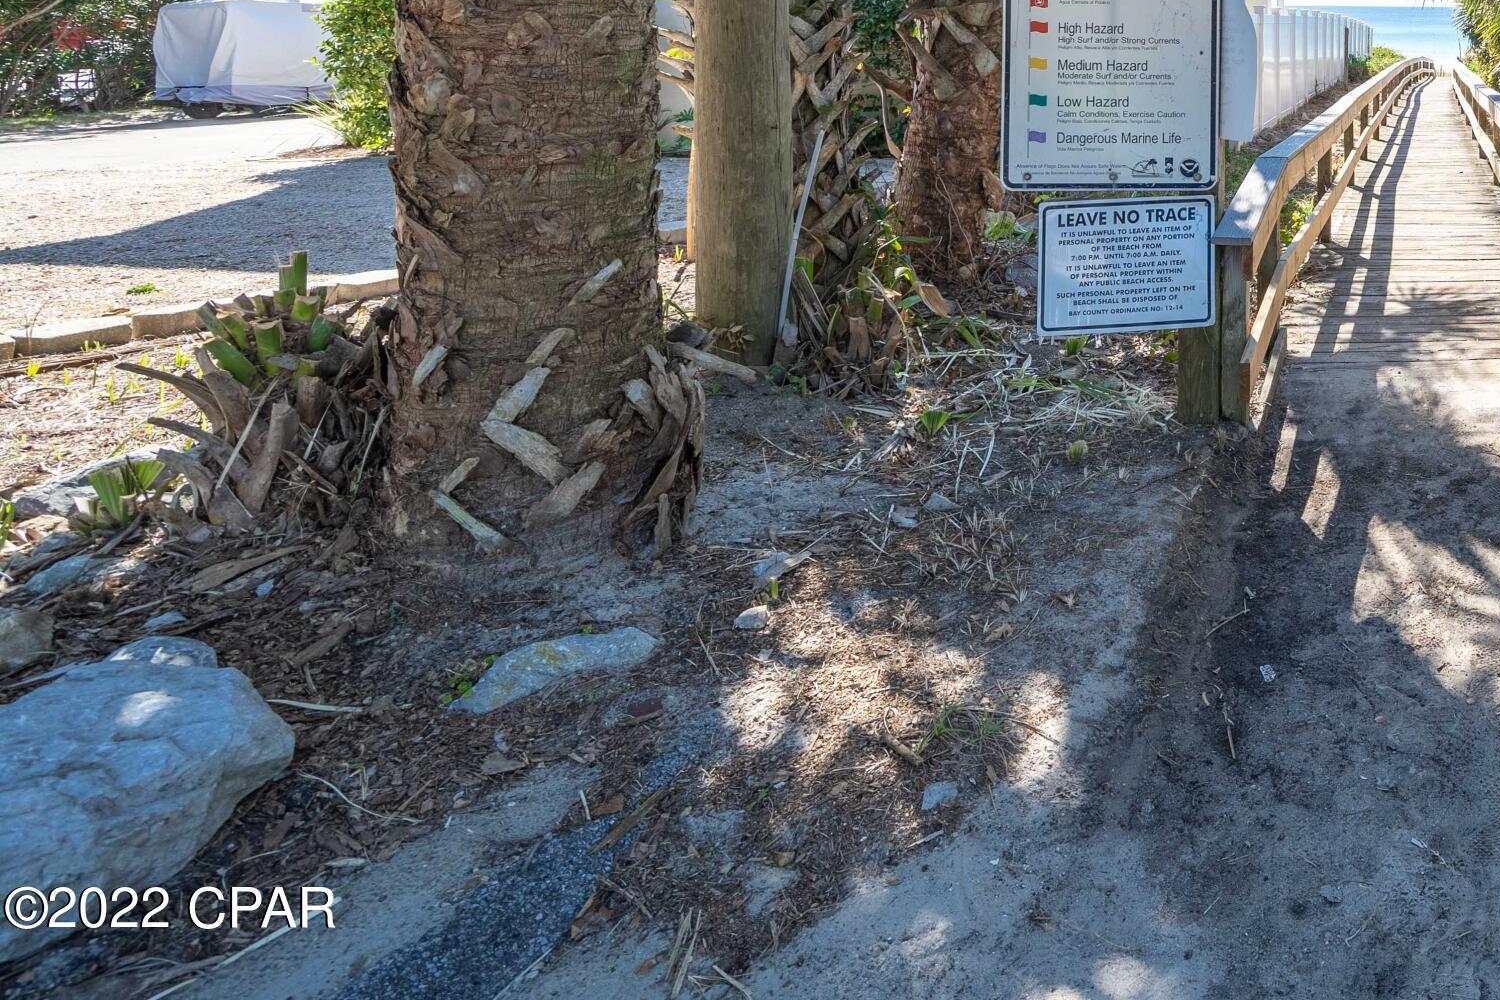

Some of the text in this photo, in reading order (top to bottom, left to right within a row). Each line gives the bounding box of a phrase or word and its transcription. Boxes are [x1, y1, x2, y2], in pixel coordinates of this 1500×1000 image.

[1058, 22, 1124, 36] High Hazard
[1121, 37, 1146, 45] Strong
[1058, 59, 1148, 71] Medium Hazard
[1057, 96, 1129, 108] Low Hazard
[1057, 132, 1181, 146] Dangerous Marine Life
[1057, 207, 1196, 227] LEAVE NO TRACE
